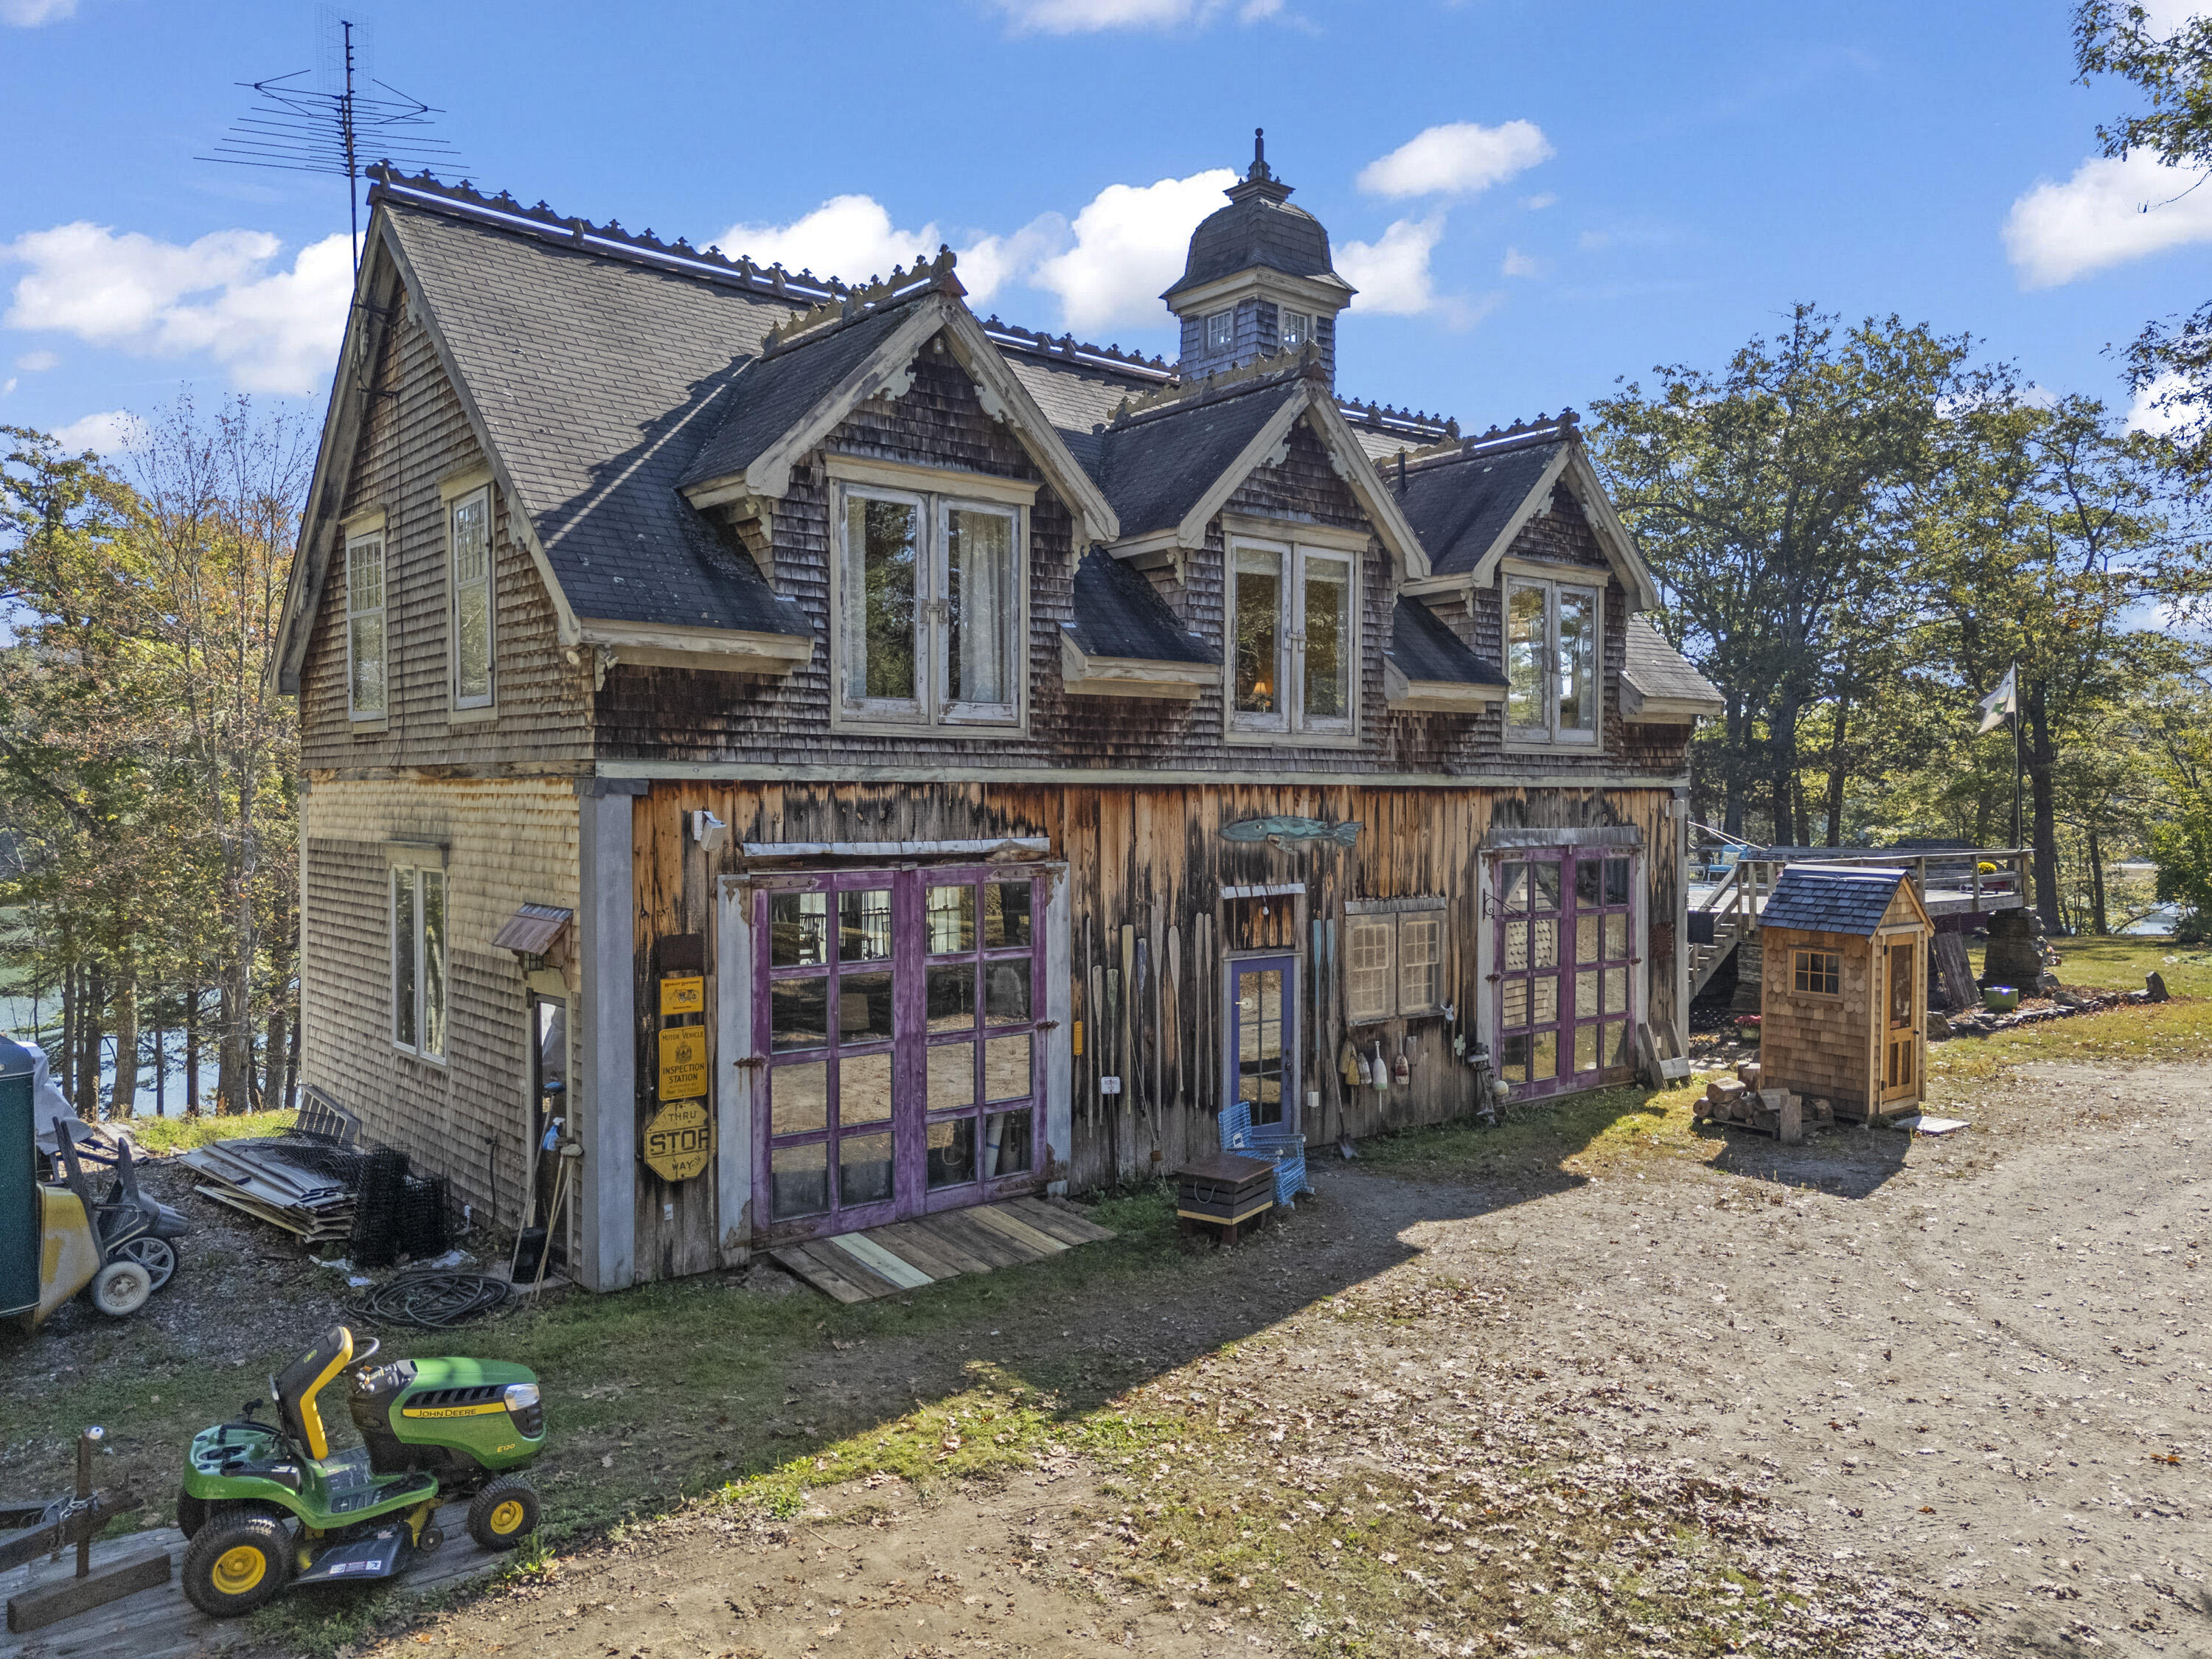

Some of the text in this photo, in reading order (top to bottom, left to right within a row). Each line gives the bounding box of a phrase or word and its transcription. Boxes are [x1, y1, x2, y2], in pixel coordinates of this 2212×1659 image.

[663, 1062, 705, 1075] INSPECTION
[669, 1074, 698, 1084] STATION
[668, 1110, 696, 1121] THRU
[672, 1161, 693, 1172] WAY
[445, 1408, 477, 1417] DEERE
[496, 1443, 516, 1453] E120
